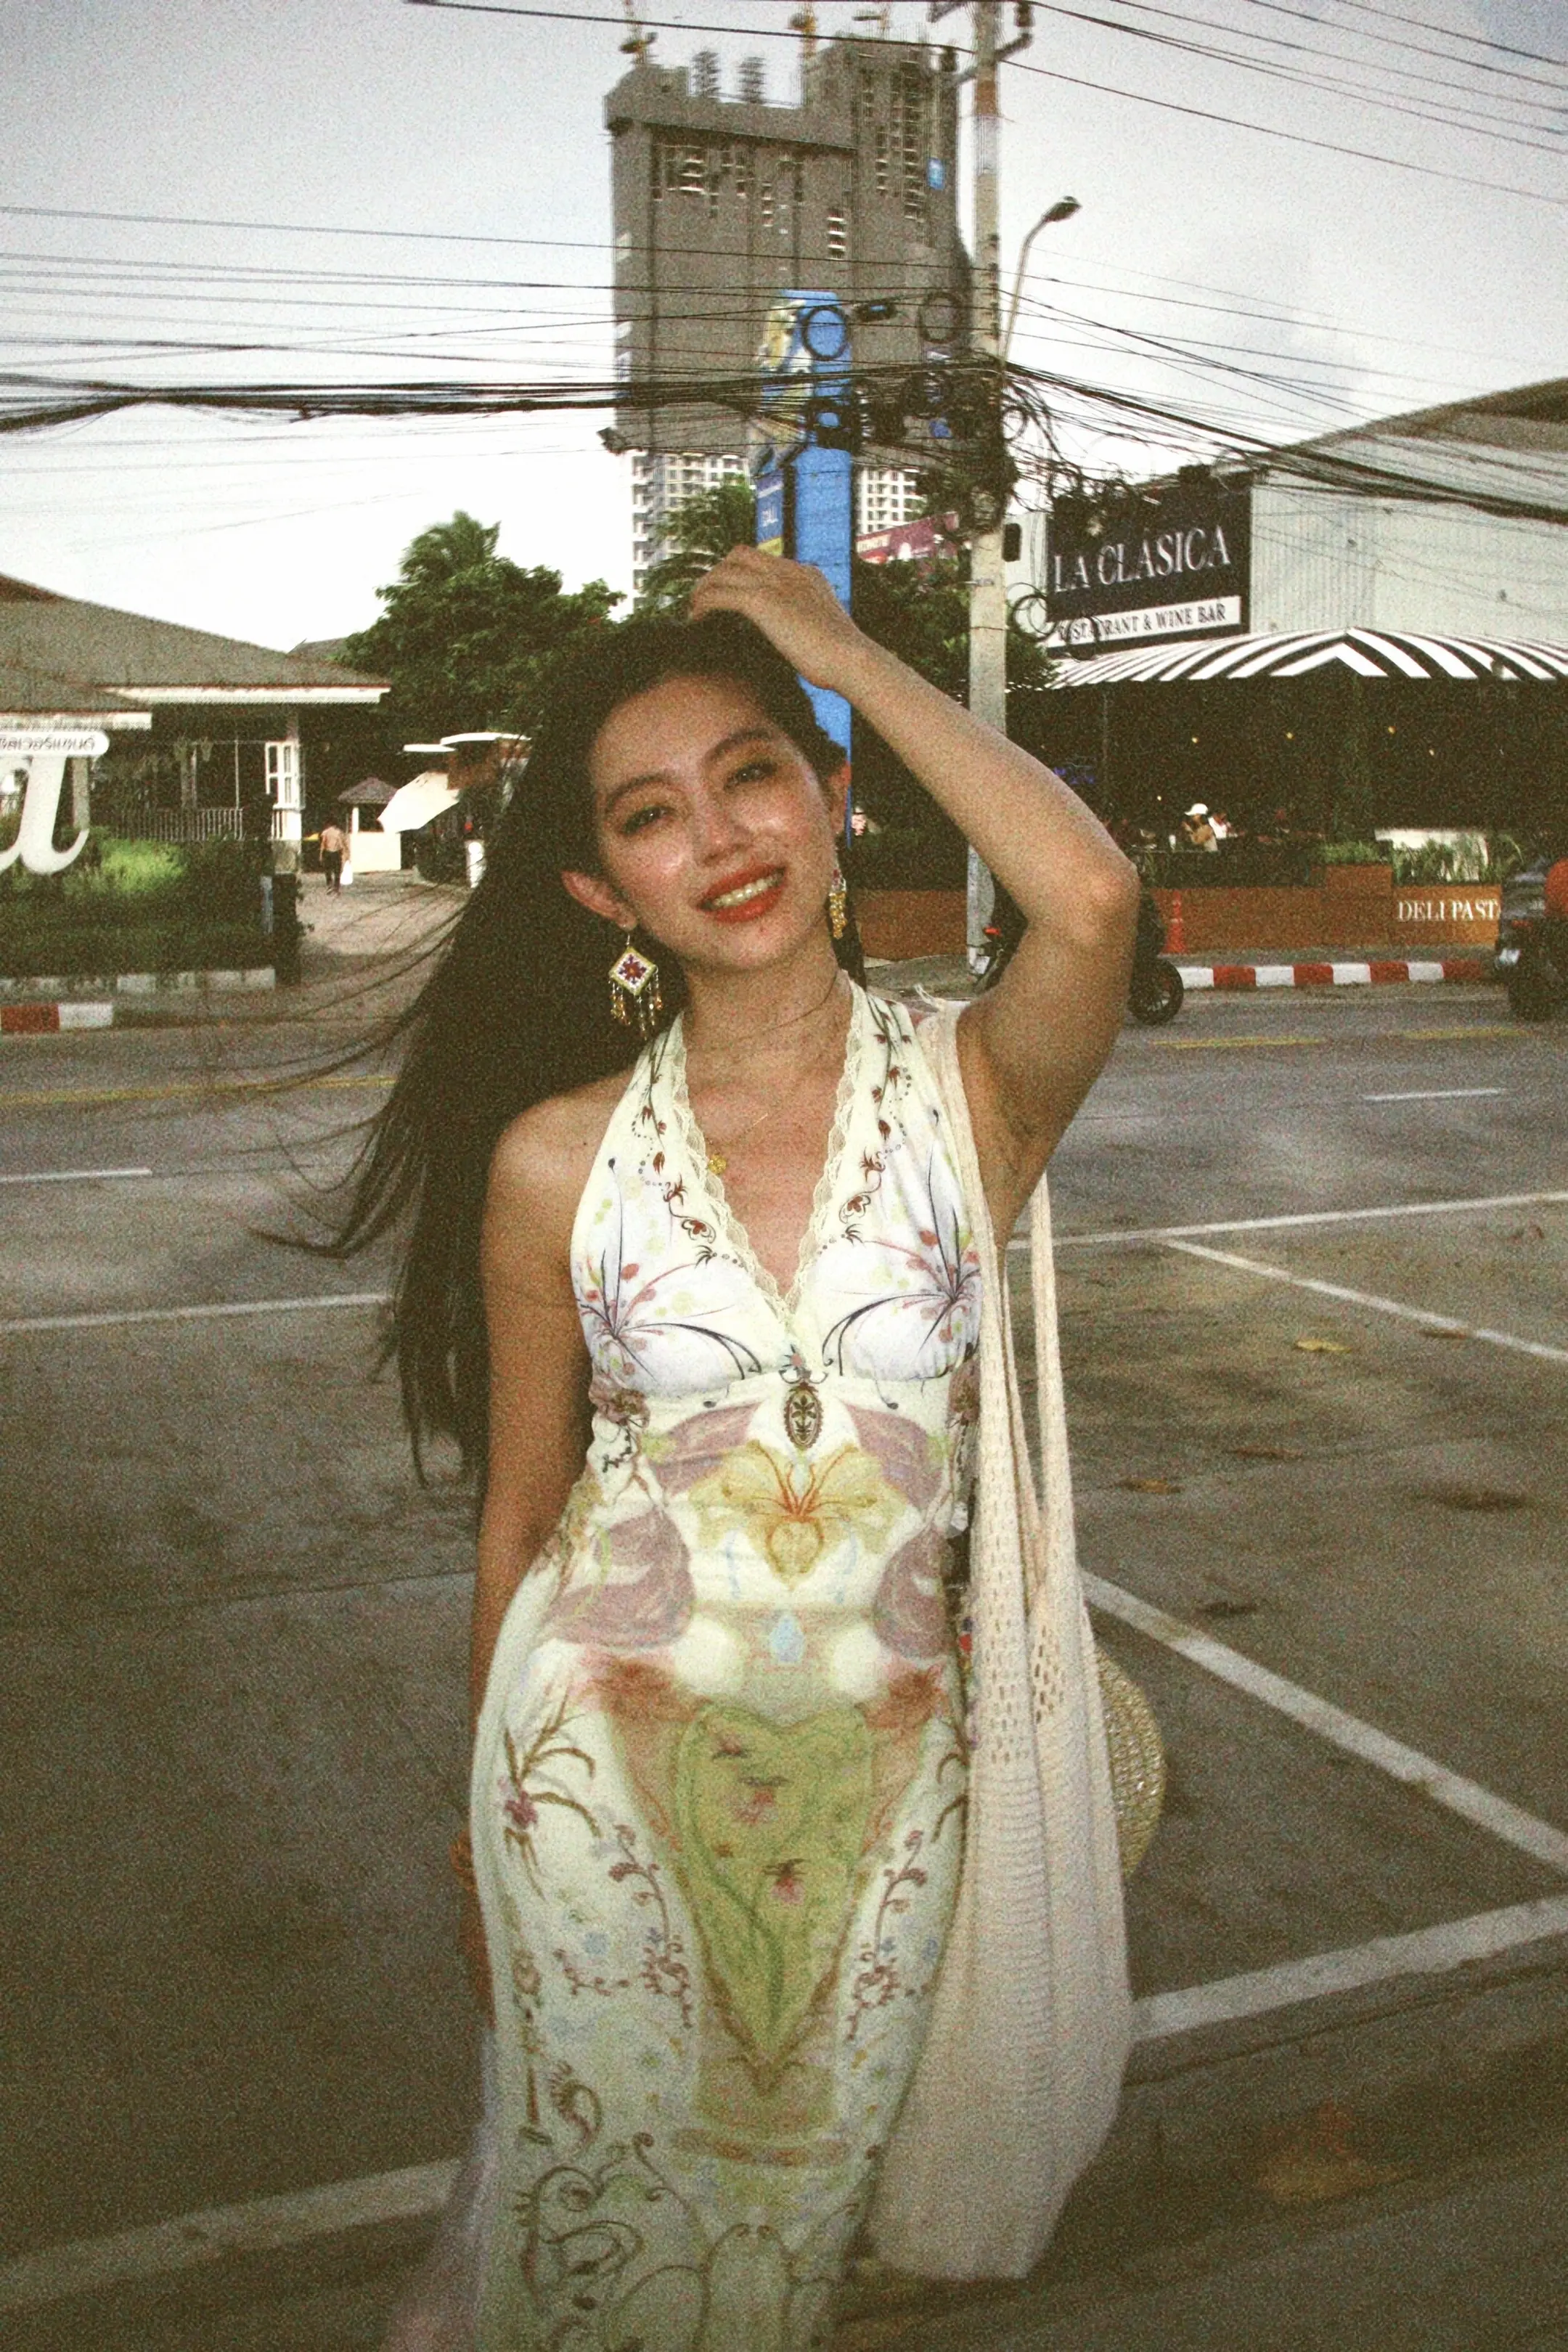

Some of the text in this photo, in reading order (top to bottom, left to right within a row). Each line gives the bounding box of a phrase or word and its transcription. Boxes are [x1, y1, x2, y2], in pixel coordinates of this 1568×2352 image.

[1053, 525, 1231, 592] LA CLASICA
[1143, 613, 1152, 631] &
[1156, 607, 1194, 629] WINE
[1198, 603, 1226, 624] BAR
[1397, 899, 1445, 922] DELI
